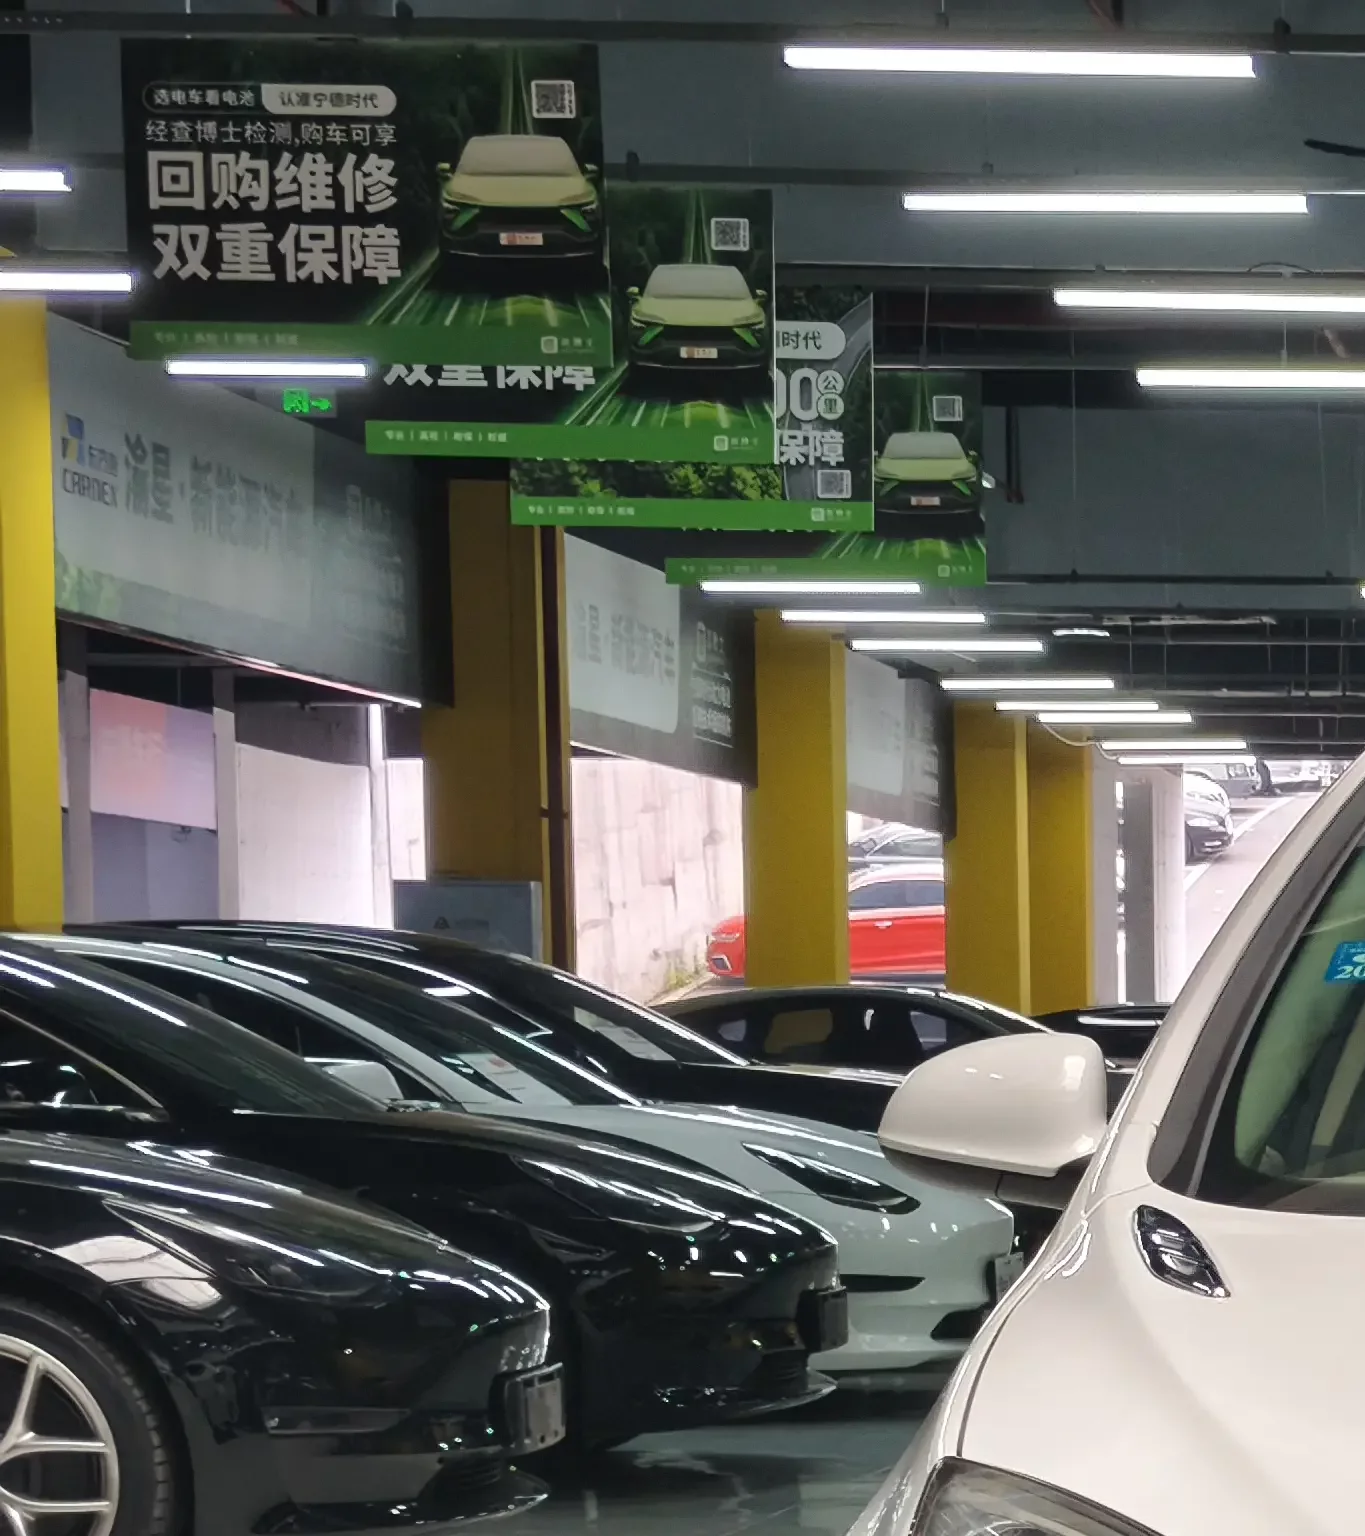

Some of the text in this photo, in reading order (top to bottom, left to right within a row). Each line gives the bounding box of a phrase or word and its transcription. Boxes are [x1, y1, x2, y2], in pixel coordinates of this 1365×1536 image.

[154, 89, 379, 109] 选电车看电池 认准宁德时代
[145, 120, 397, 146] 经查博士检测,购车可享
[147, 150, 398, 213] 回购维修
[152, 222, 402, 285] 双重保障
[776, 330, 822, 350] 时代
